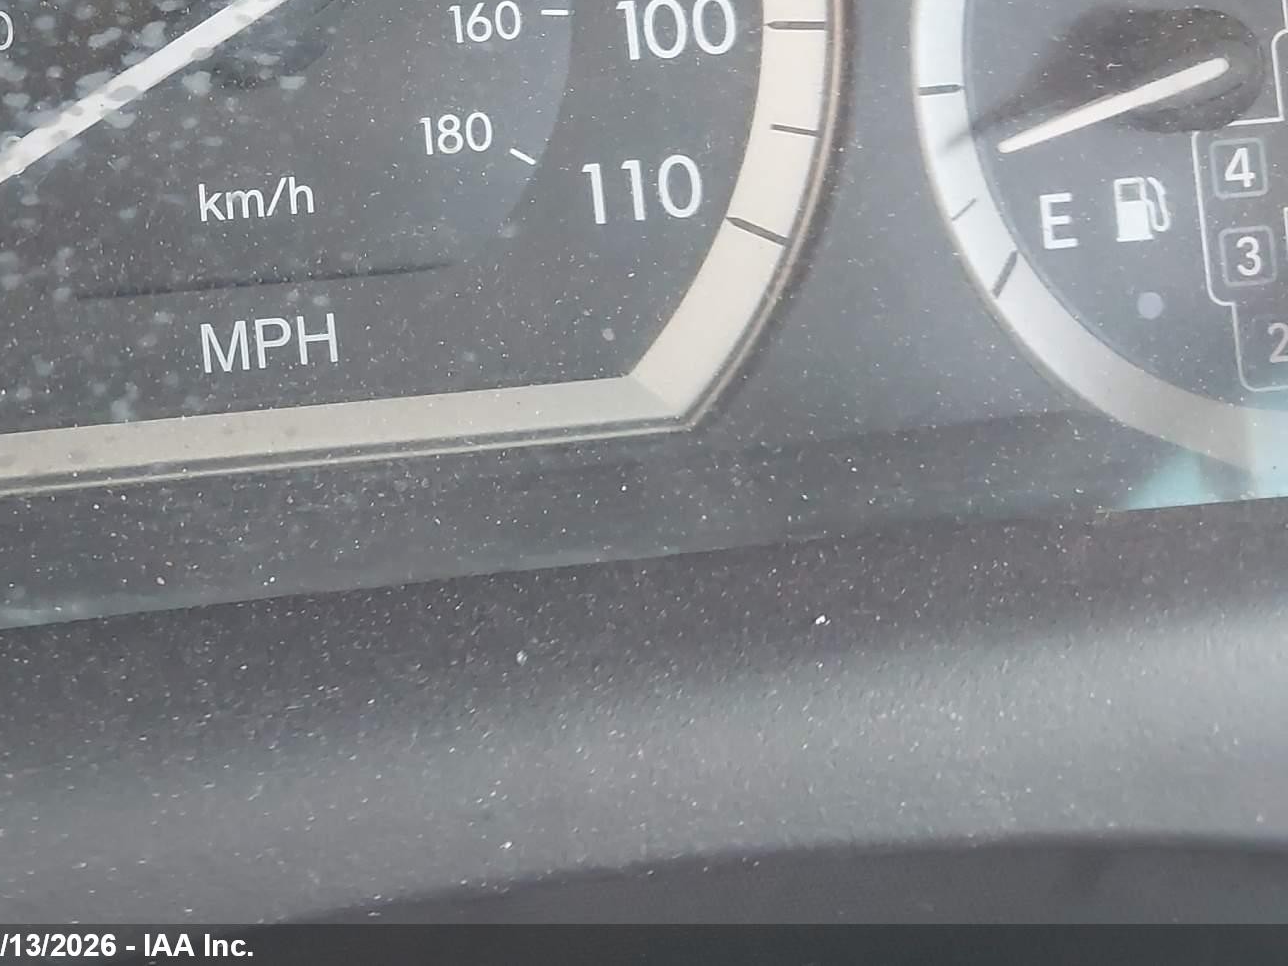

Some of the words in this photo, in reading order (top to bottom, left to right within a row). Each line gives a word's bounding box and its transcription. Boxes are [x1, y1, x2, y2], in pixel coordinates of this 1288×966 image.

[448, 2, 522, 42] 160
[419, 113, 492, 156] 180
[581, 154, 703, 224] 110
[1225, 148, 1255, 187] 4
[197, 178, 315, 224] km/h
[1040, 193, 1076, 250] E
[1236, 237, 1261, 276] 3
[199, 311, 339, 376] MPH
[1268, 323, 1288, 363] 2
